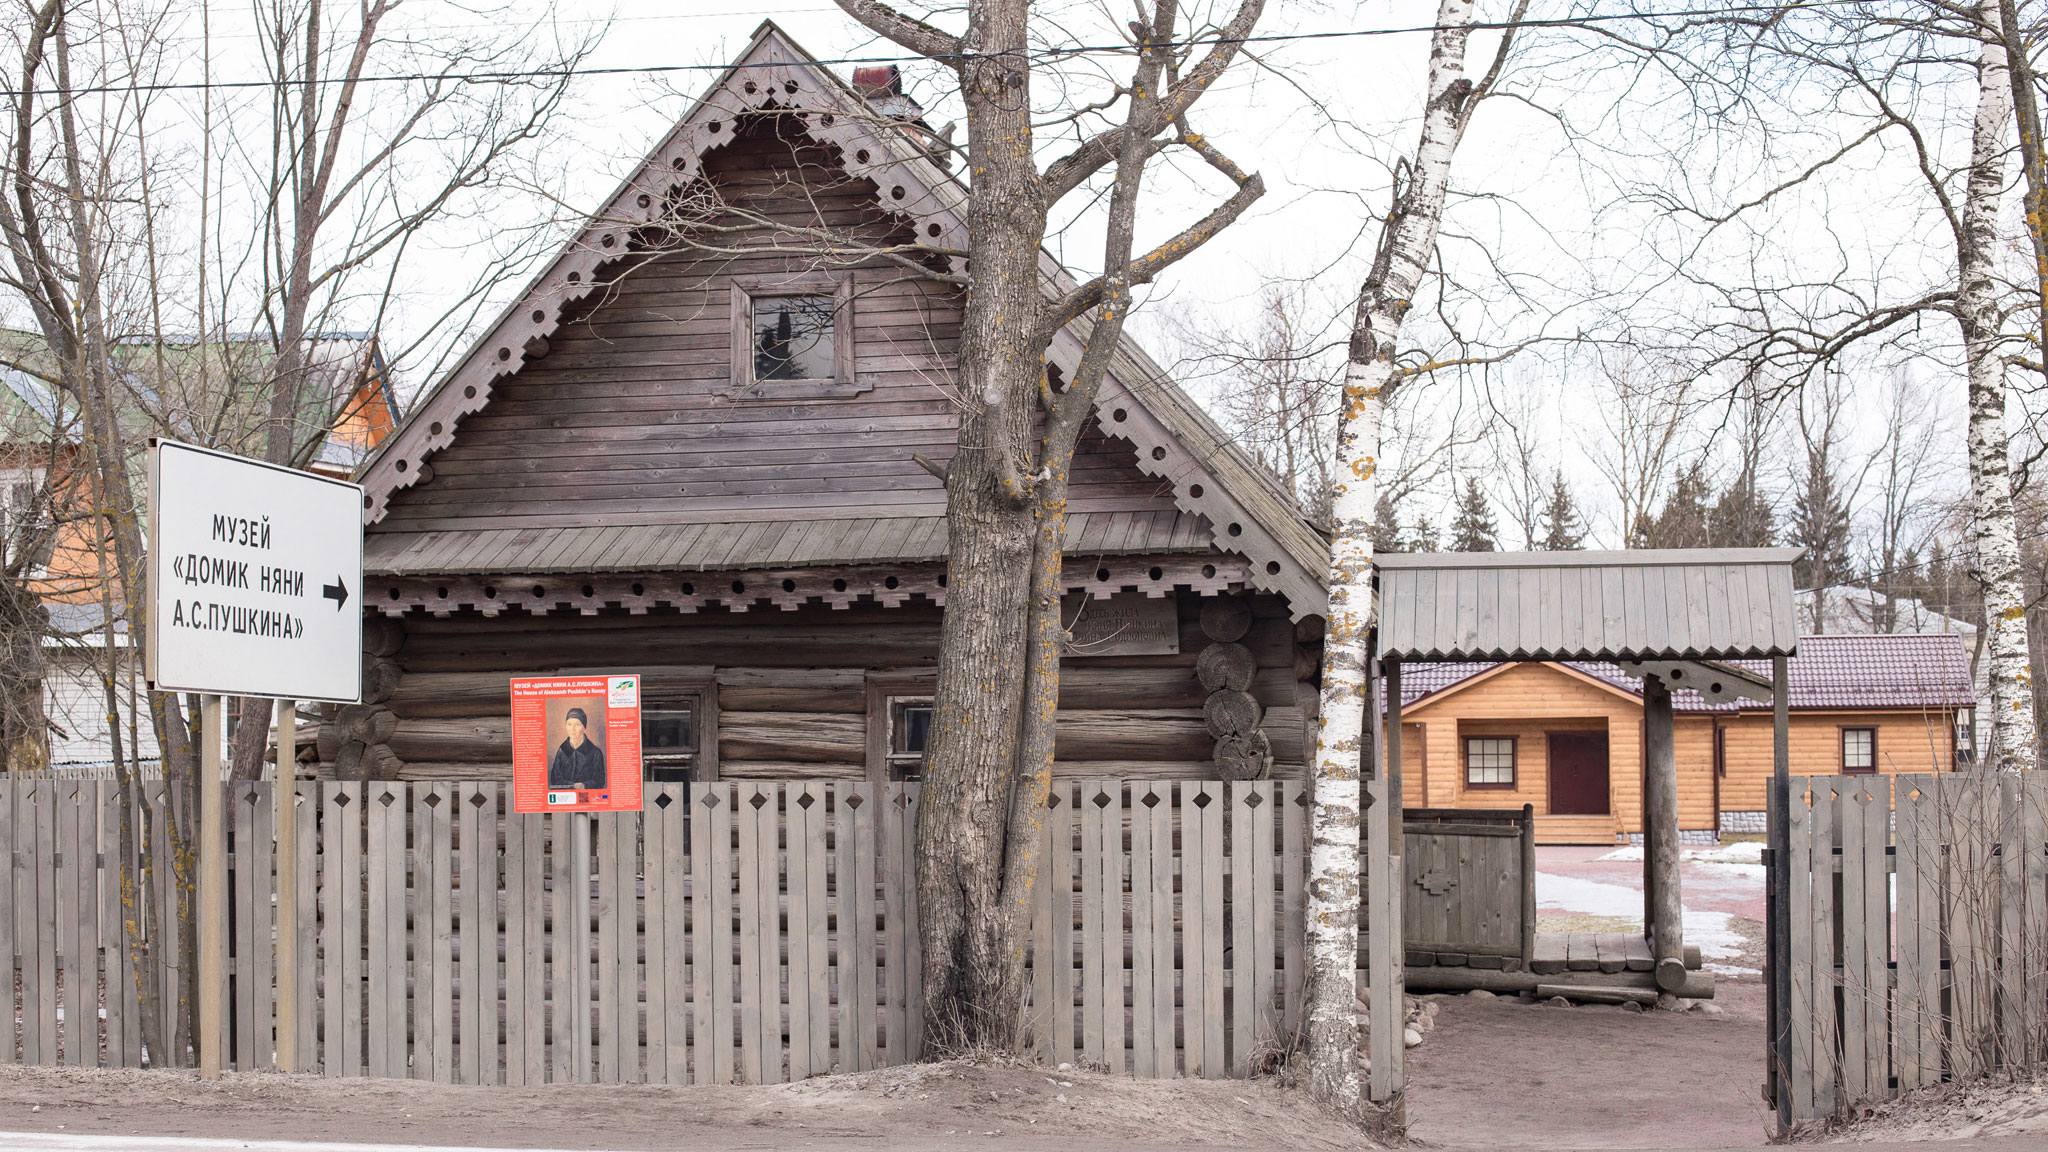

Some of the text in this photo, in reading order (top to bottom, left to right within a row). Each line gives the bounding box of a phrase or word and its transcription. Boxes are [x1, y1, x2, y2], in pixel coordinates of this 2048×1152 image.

[212, 513, 271, 550] МУЗЕЙ
[173, 553, 304, 597] «ДОМИК НЯНИ
[172, 599, 304, 639] А.С.ПУШКИНА»
[591, 688, 606, 696] Nanny
